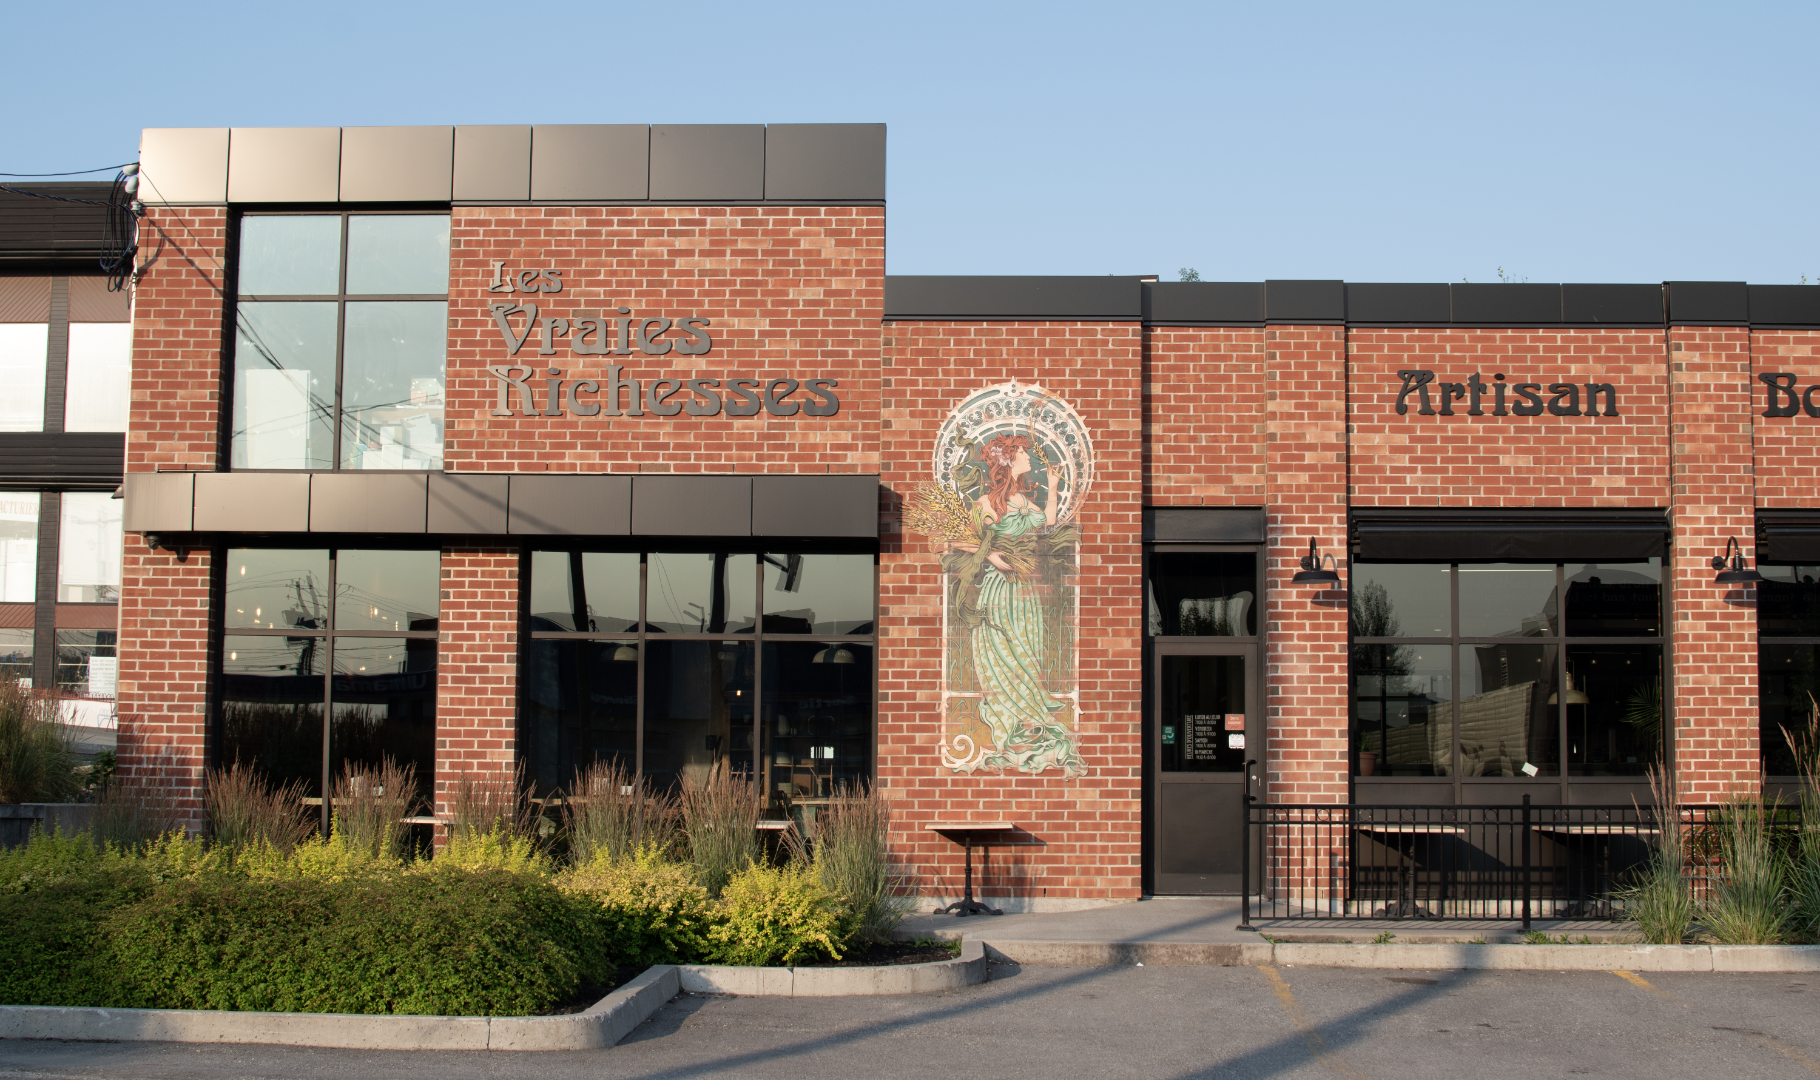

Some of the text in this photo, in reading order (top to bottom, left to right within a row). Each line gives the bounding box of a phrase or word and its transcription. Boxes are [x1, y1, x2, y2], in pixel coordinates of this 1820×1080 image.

[488, 261, 563, 293] Les
[488, 303, 712, 356] Vraies
[488, 364, 840, 417] Richesses
[1395, 369, 1620, 417] Artisan
